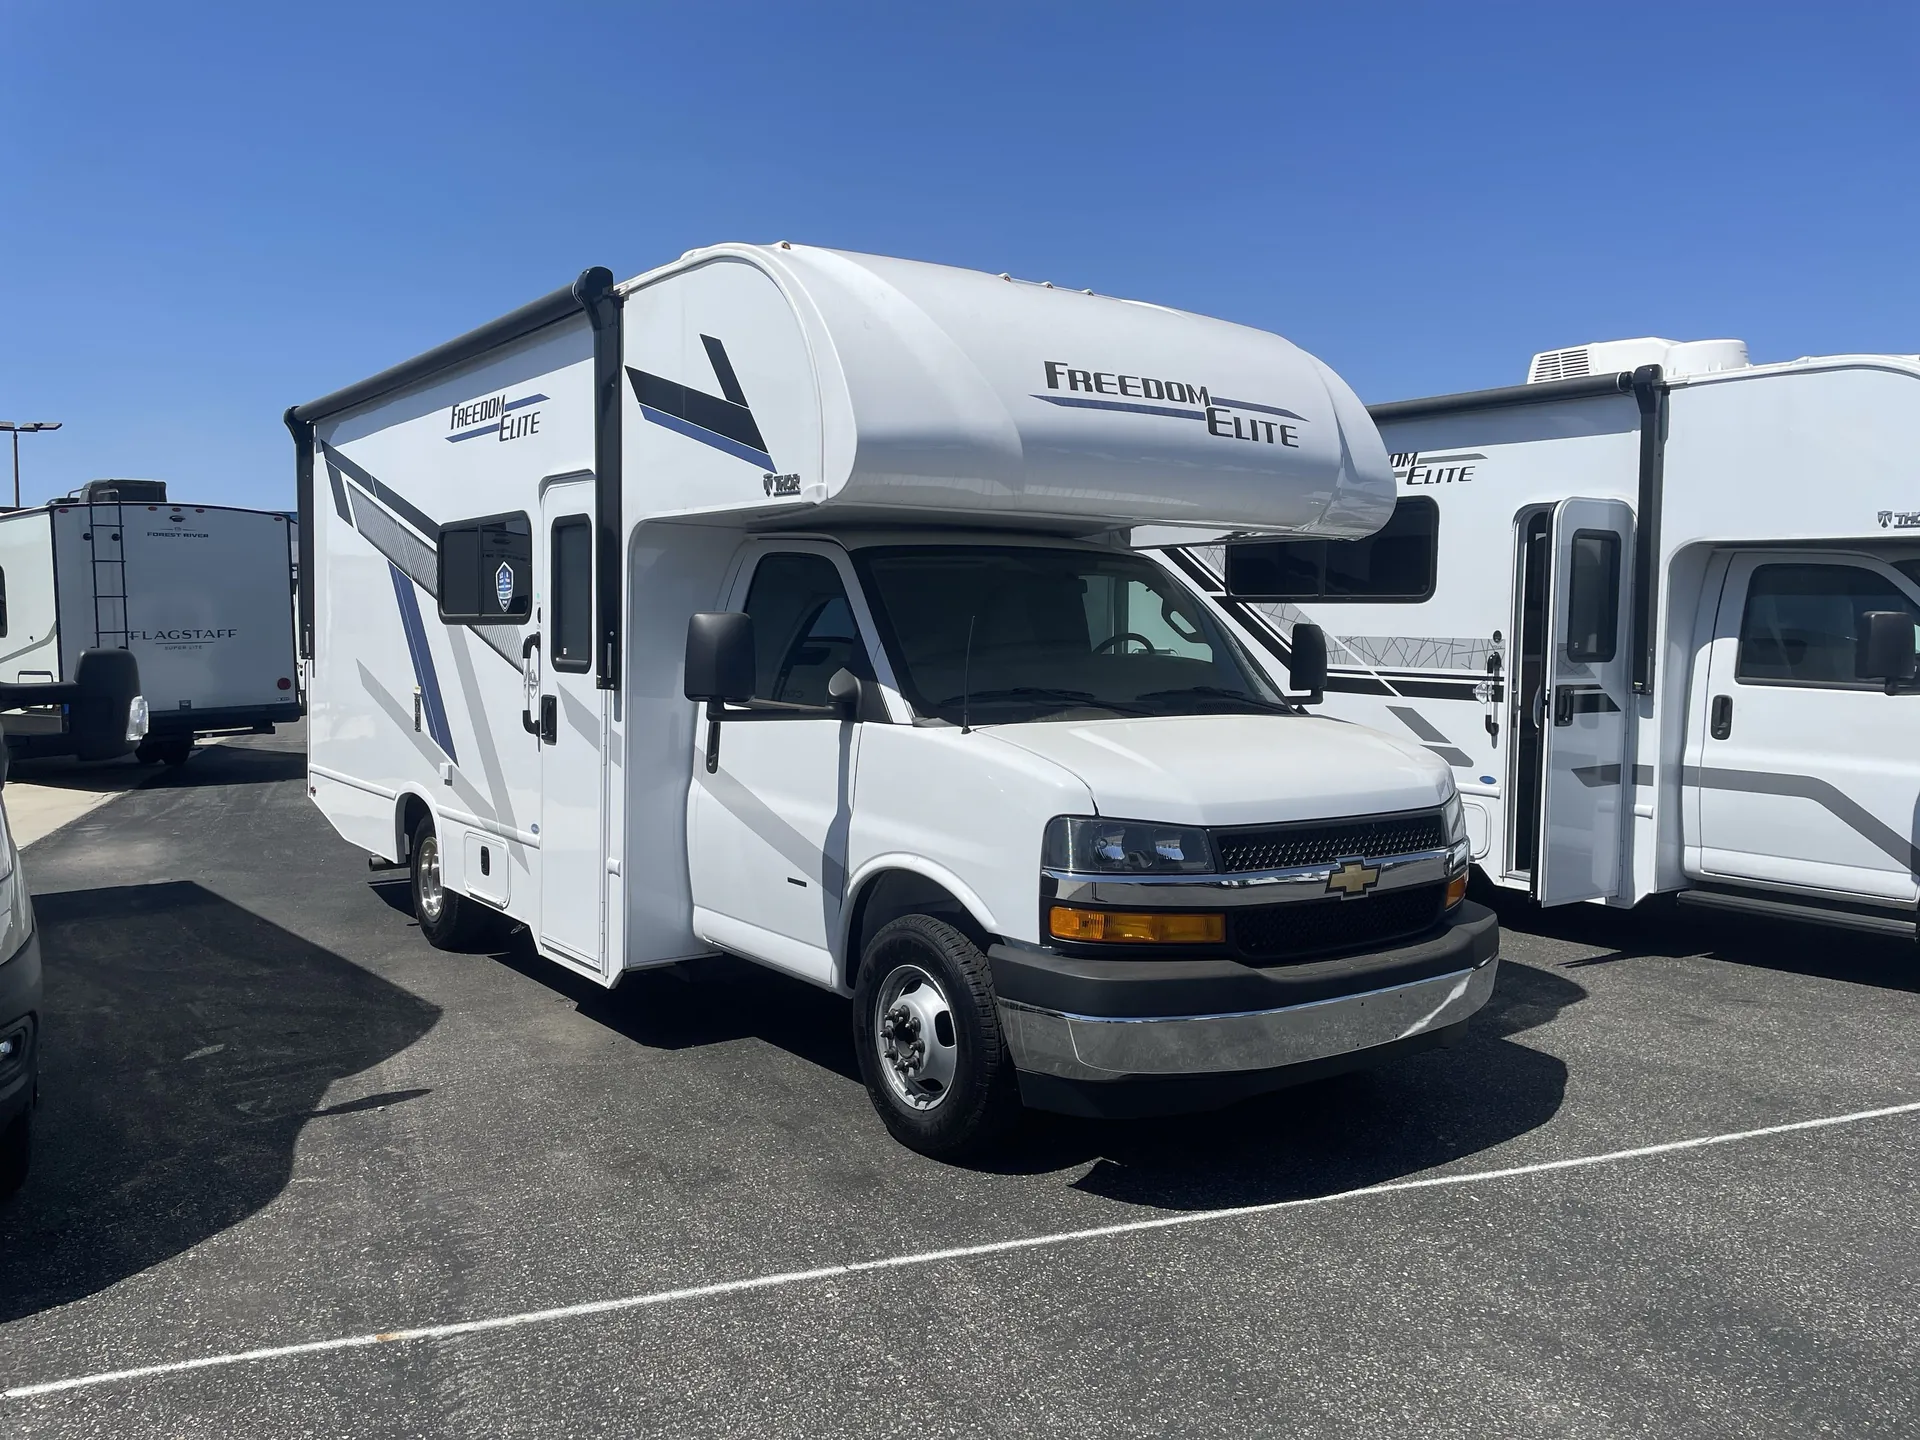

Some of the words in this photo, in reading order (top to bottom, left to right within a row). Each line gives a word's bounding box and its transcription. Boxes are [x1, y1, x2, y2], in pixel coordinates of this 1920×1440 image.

[1045, 360, 1211, 407] FREEDOM
[450, 395, 505, 430] FREEDOM
[499, 411, 540, 442] ELITE
[1206, 406, 1299, 448] ELITE
[774, 474, 801, 492] THOR
[1406, 466, 1475, 485] ELITE
[130, 629, 237, 640] FLAGSTAFF
